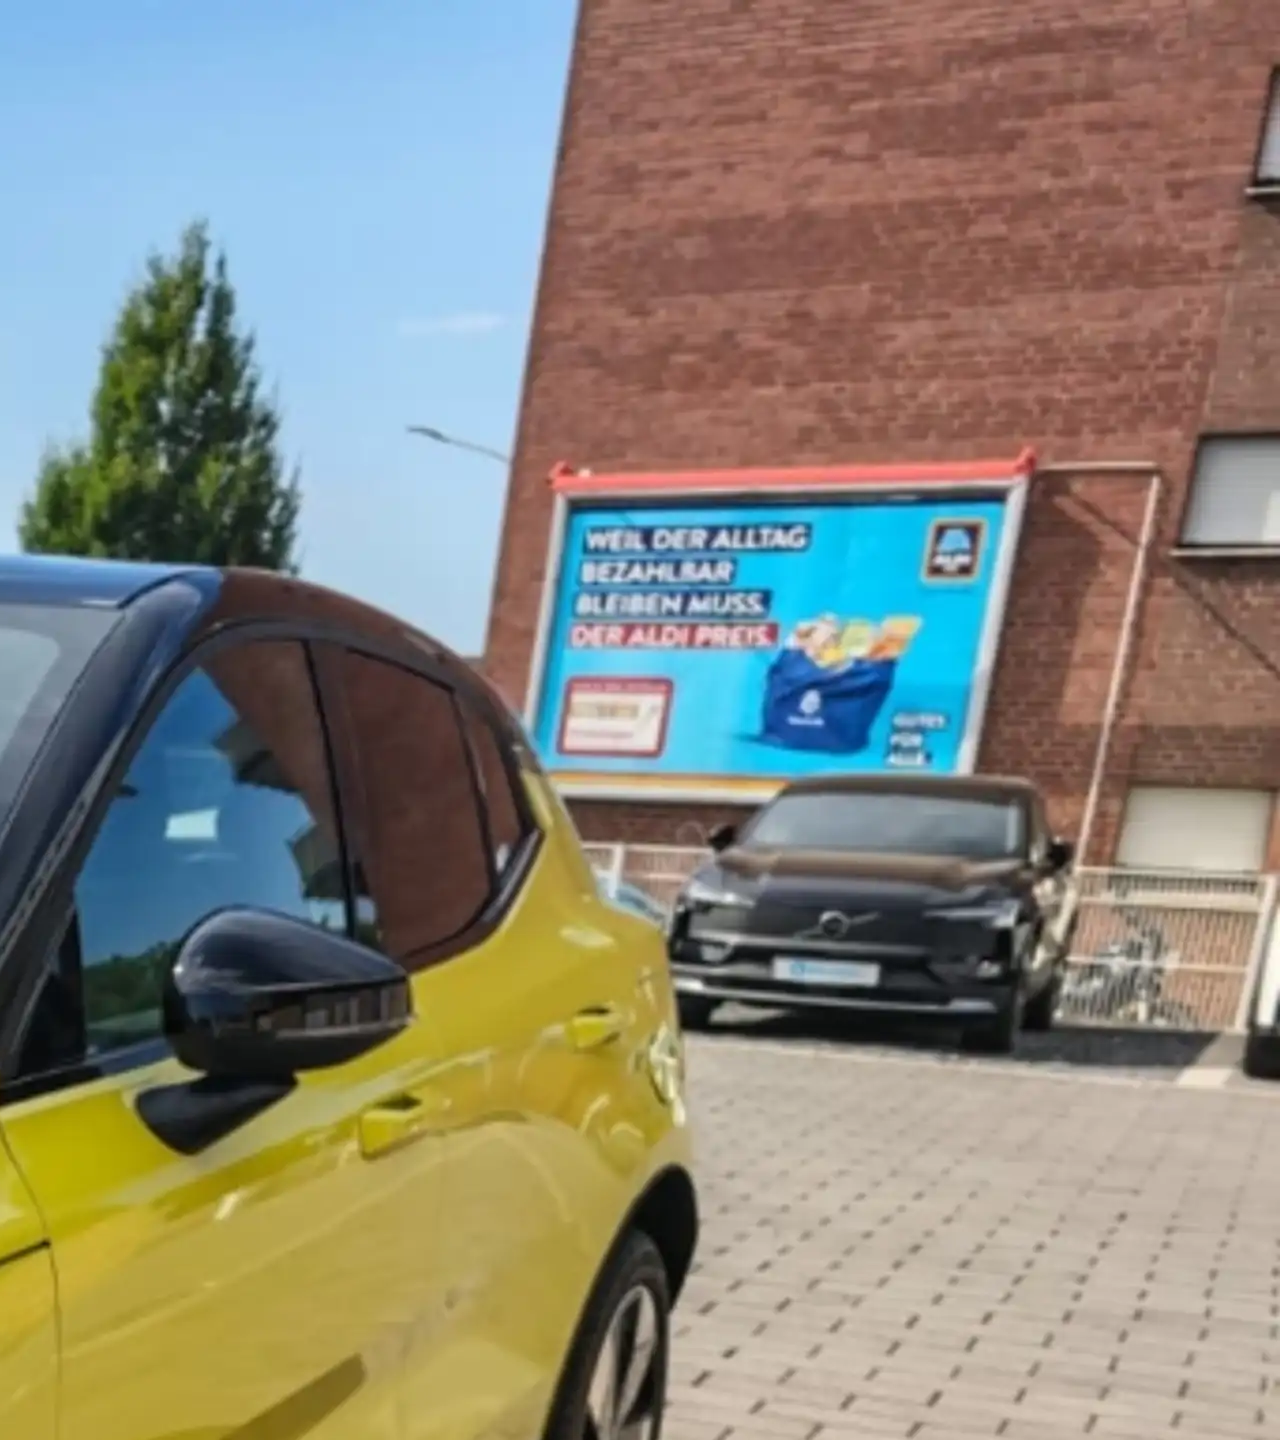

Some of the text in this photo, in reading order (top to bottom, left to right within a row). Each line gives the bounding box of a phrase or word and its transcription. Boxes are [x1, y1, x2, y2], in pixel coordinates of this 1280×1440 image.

[585, 526, 806, 550] WEIL DER ALLTAG
[581, 560, 733, 583] BEZAHLBAR
[575, 593, 683, 615] BLEIBEN
[571, 625, 625, 646] DER
[627, 624, 685, 646] ALDI
